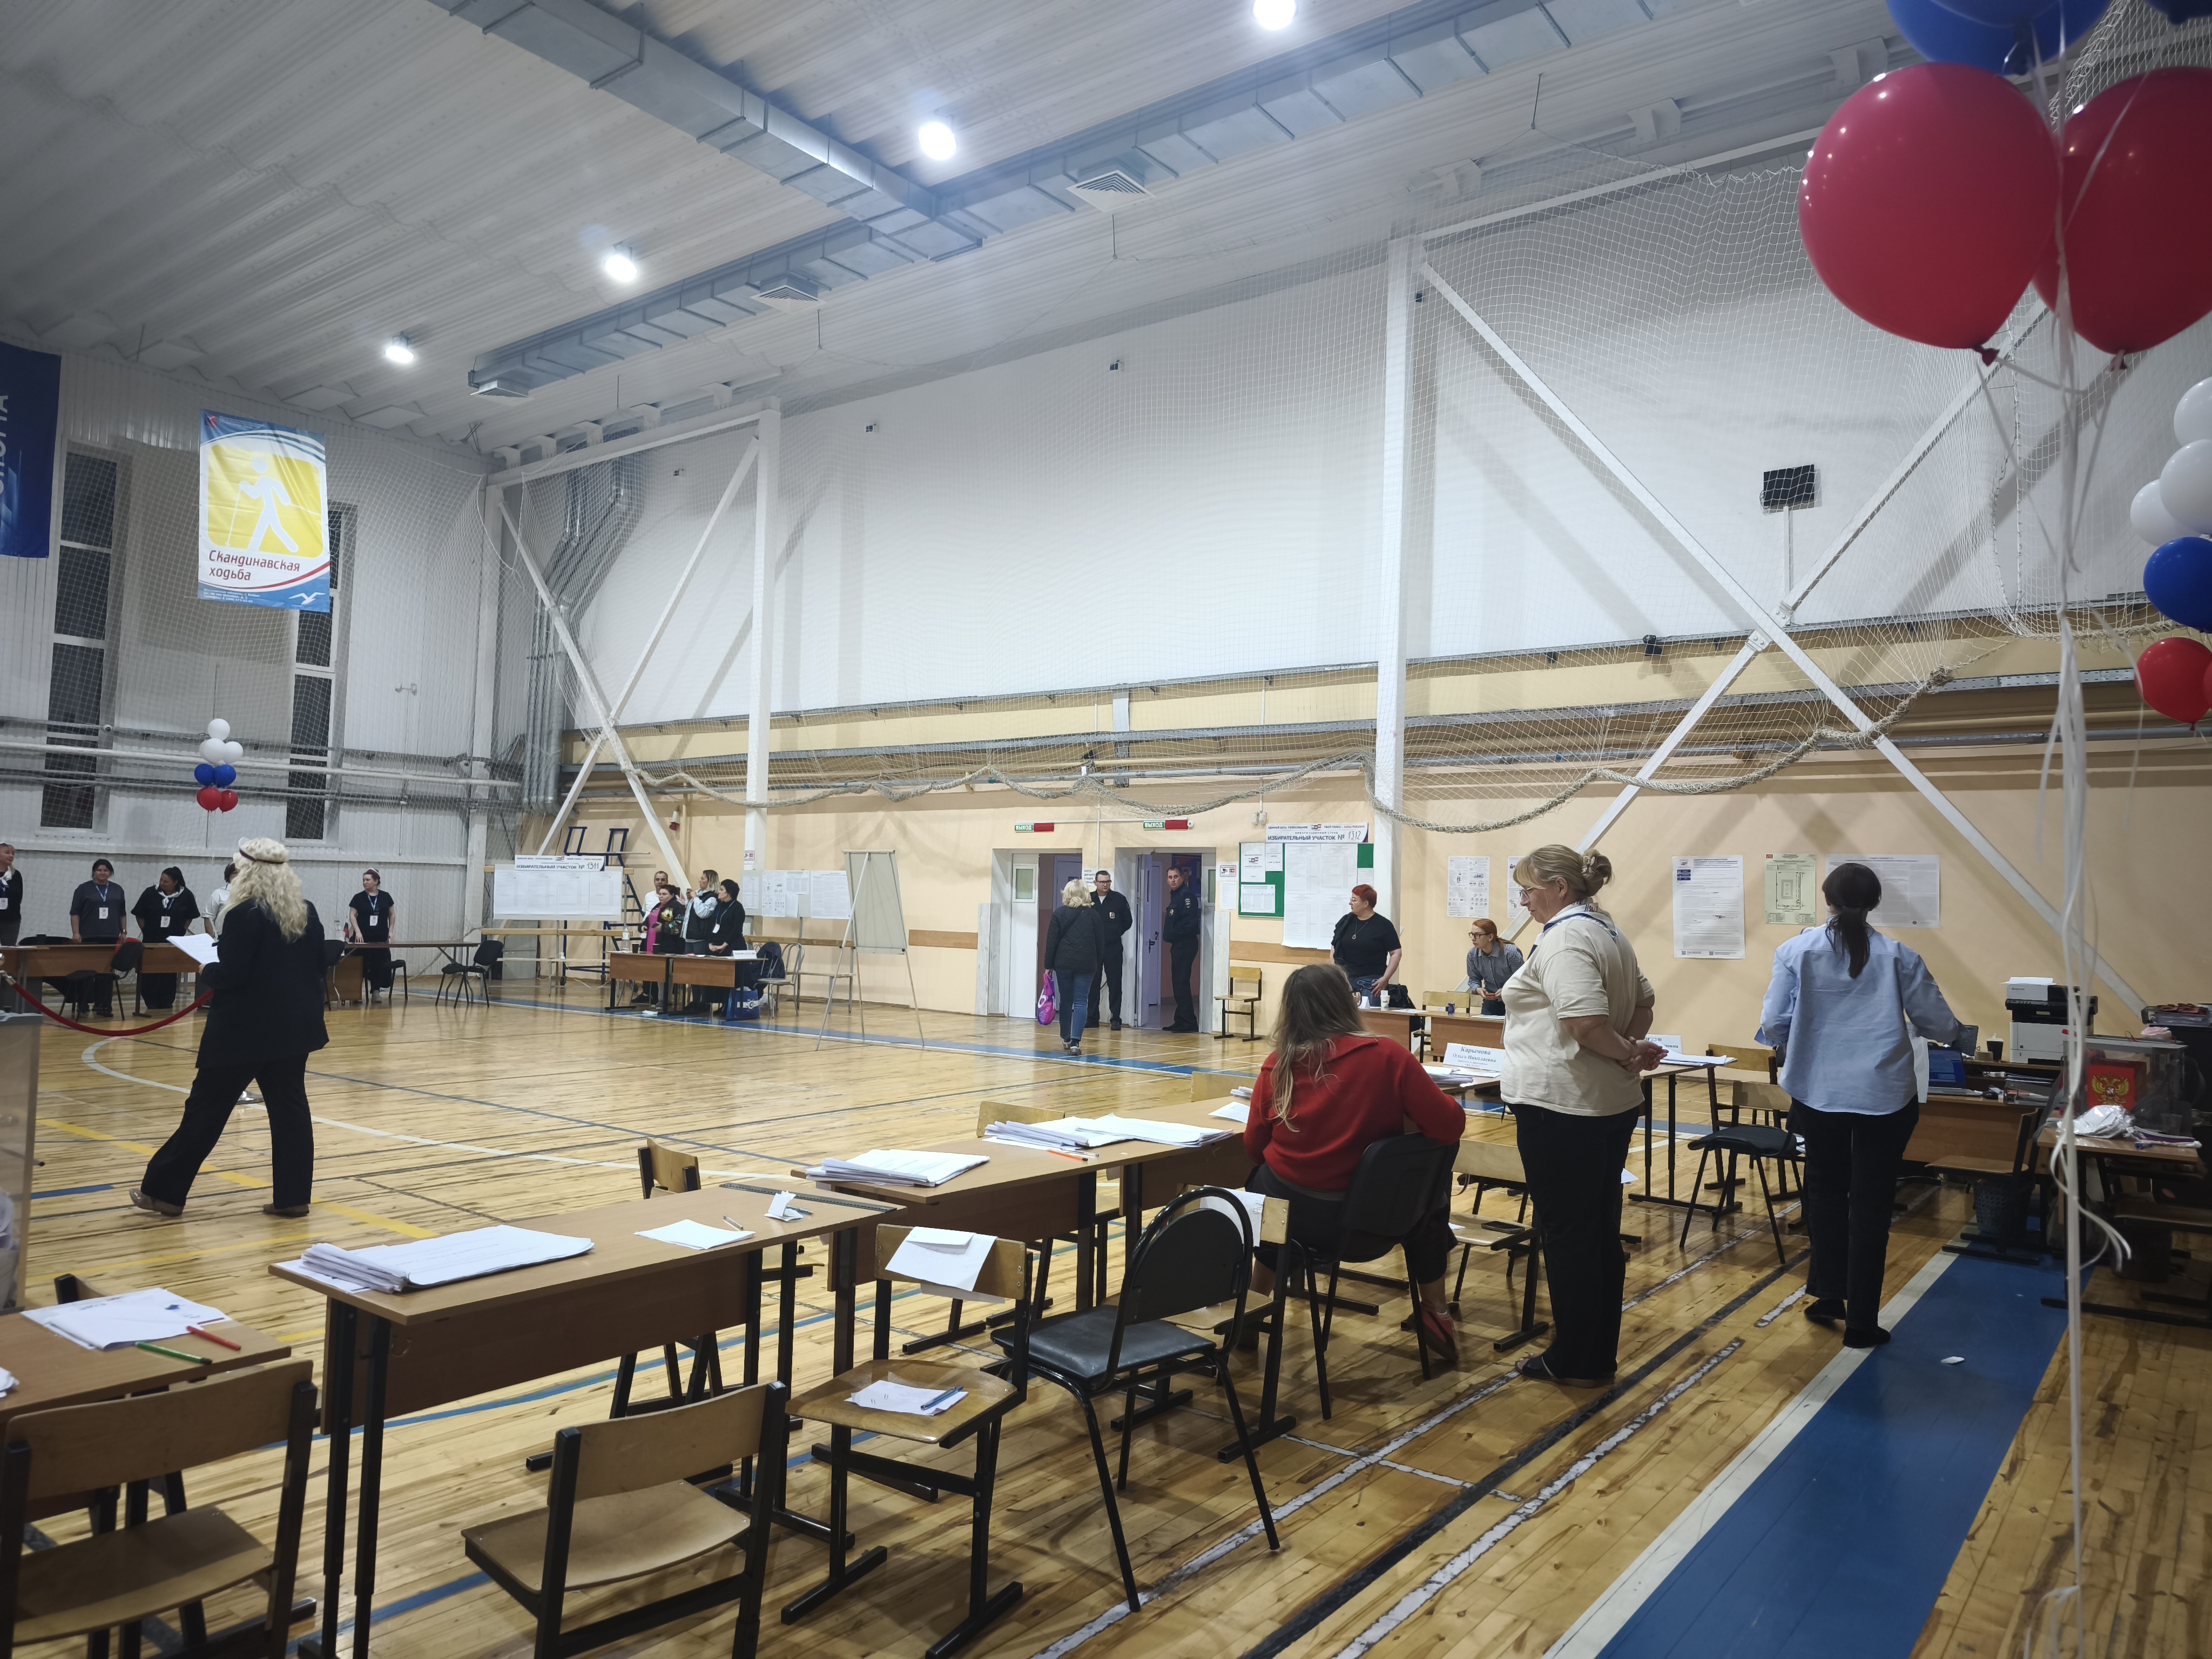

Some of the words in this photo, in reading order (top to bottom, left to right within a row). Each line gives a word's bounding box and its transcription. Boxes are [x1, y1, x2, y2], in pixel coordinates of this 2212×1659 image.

[208, 550, 300, 572] Скандинавская
[208, 567, 252, 581] ходьба
[1348, 831, 1361, 840] 1312
[1460, 1046, 1491, 1055] Карымова
